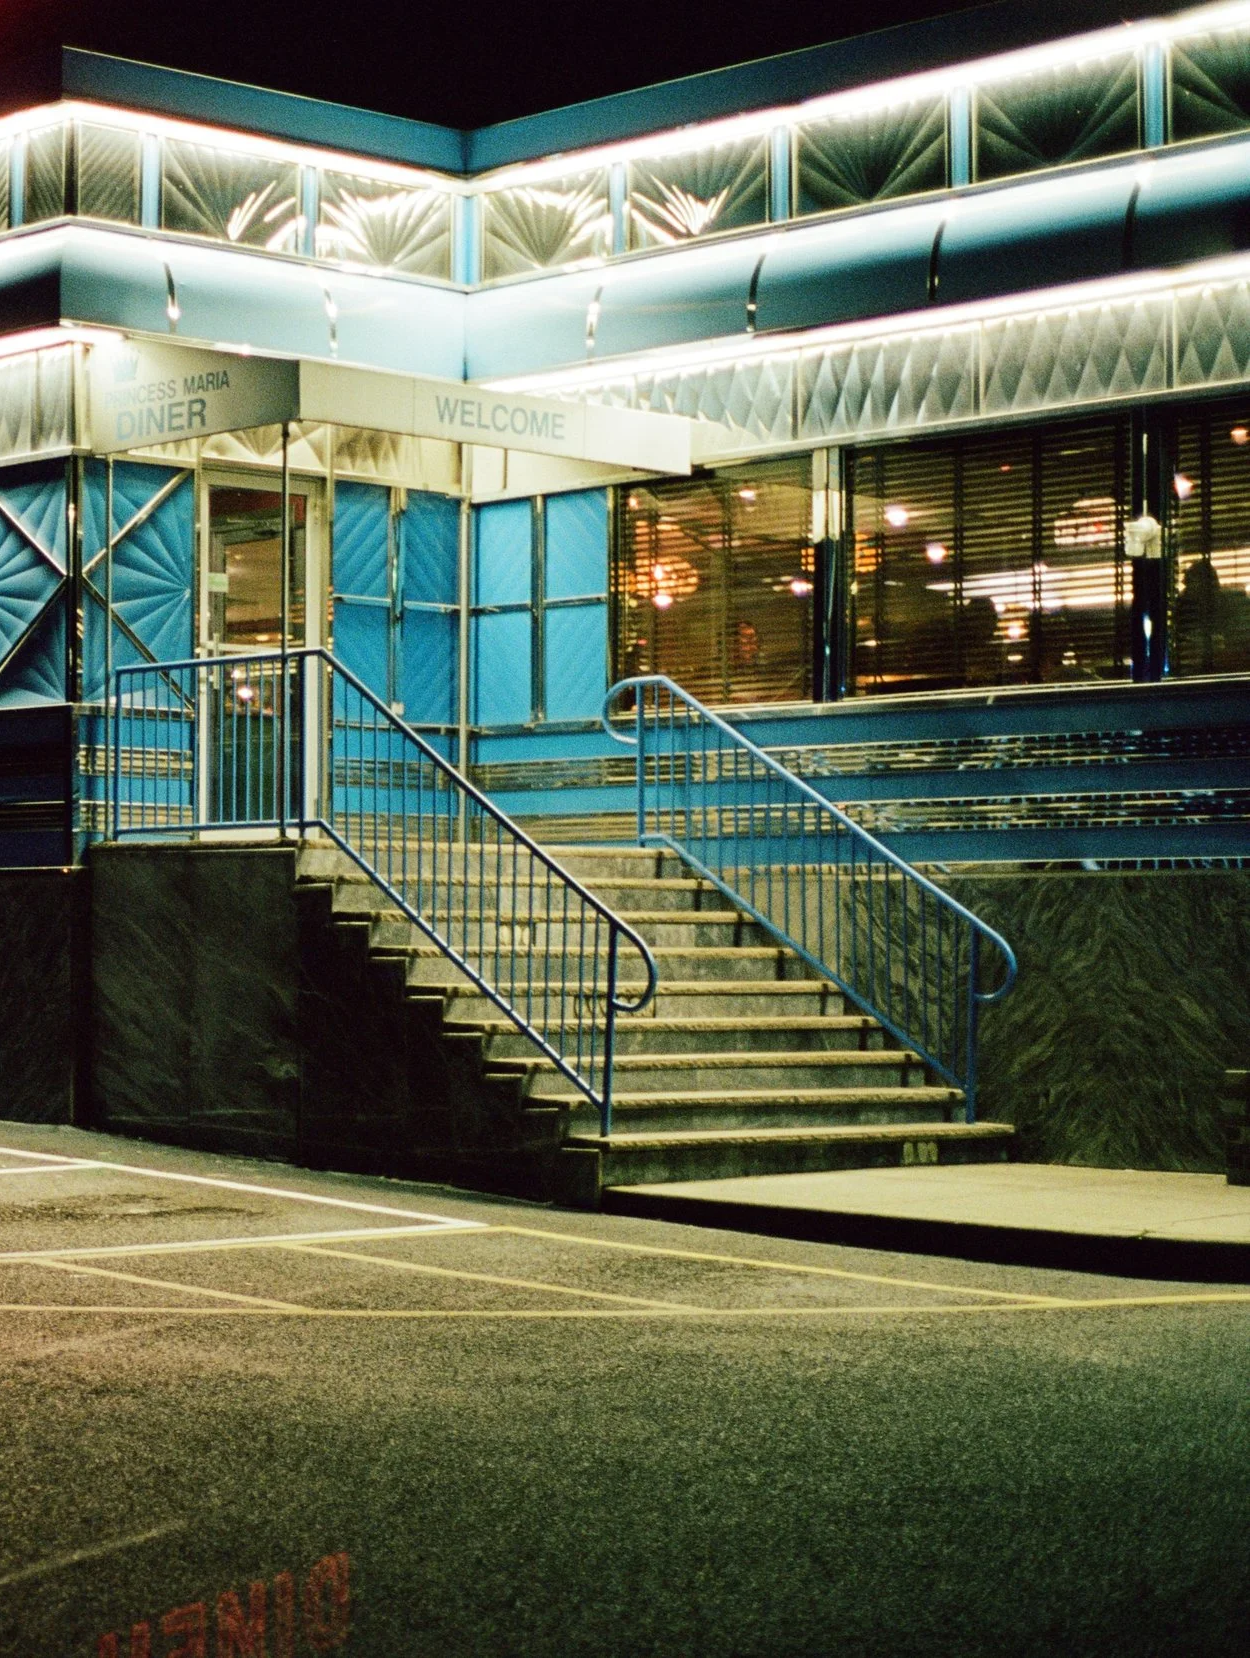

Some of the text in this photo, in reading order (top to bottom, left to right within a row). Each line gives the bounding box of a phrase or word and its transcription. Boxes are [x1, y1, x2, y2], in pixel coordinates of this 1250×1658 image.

[183, 369, 230, 396] MARIA
[116, 398, 207, 441] DINER
[435, 395, 566, 440] WELCOME
